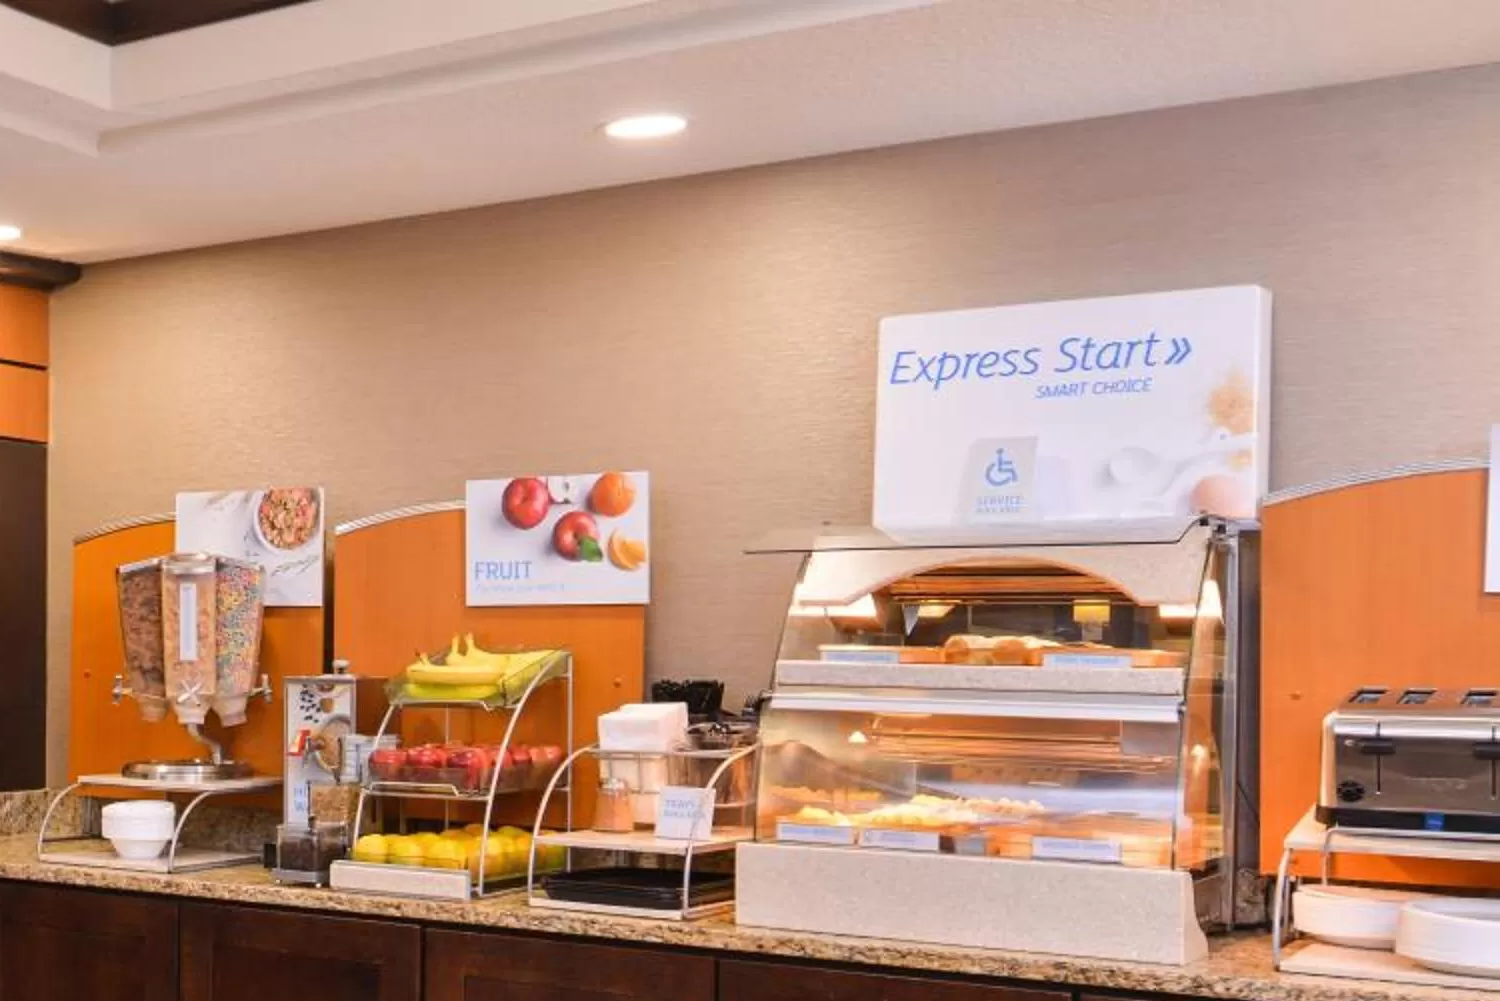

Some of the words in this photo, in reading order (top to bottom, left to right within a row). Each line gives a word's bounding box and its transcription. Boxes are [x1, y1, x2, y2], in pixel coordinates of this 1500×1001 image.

[890, 347, 1042, 391] Express
[1034, 381, 1088, 399] SMART
[1092, 376, 1154, 396] CHOICE
[474, 561, 533, 580] FRUIT
